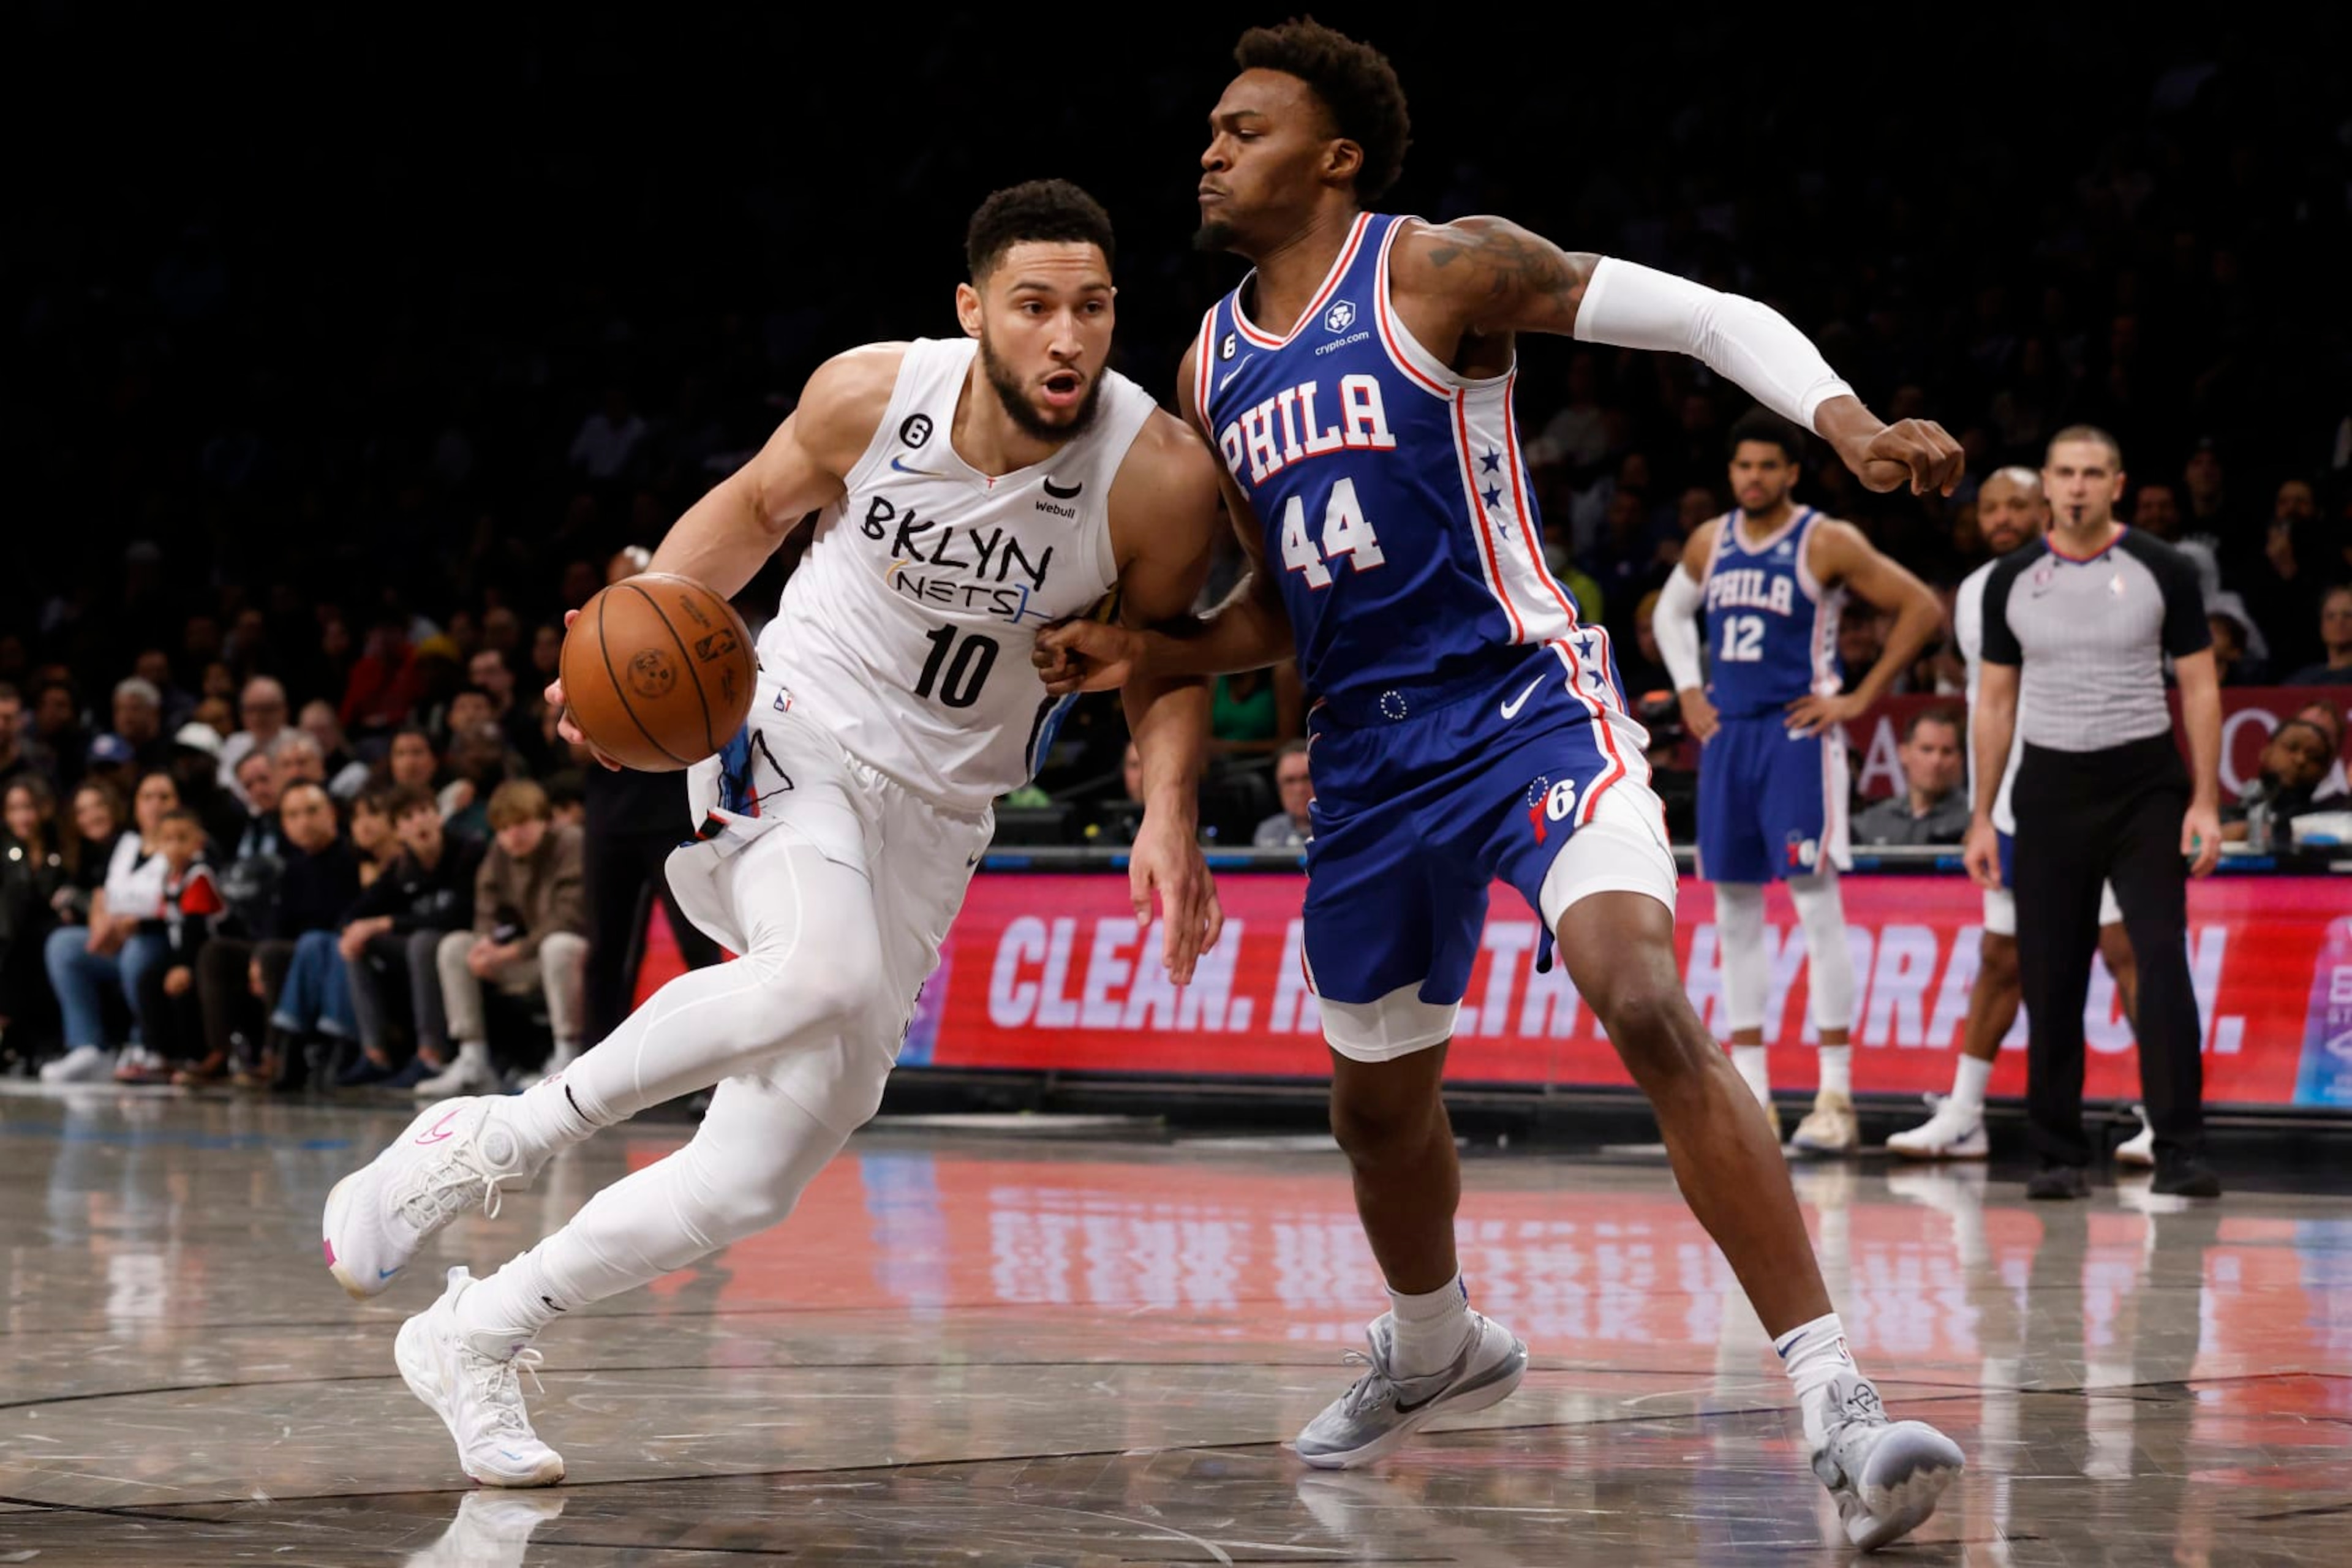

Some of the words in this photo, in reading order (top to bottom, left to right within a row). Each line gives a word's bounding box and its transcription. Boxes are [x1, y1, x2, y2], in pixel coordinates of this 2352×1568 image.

[1223, 333, 1236, 359] 6
[1314, 331, 1370, 356] crypto.com
[1219, 374, 1396, 502] PHILA
[861, 497, 1053, 592] BKLYN
[1281, 477, 1385, 589] 44
[897, 571, 1019, 616] NETS
[1708, 569, 1793, 616] PHILA
[914, 624, 999, 708] 10
[1720, 614, 1765, 662] 12
[987, 916, 1253, 1031] CLEAN.
